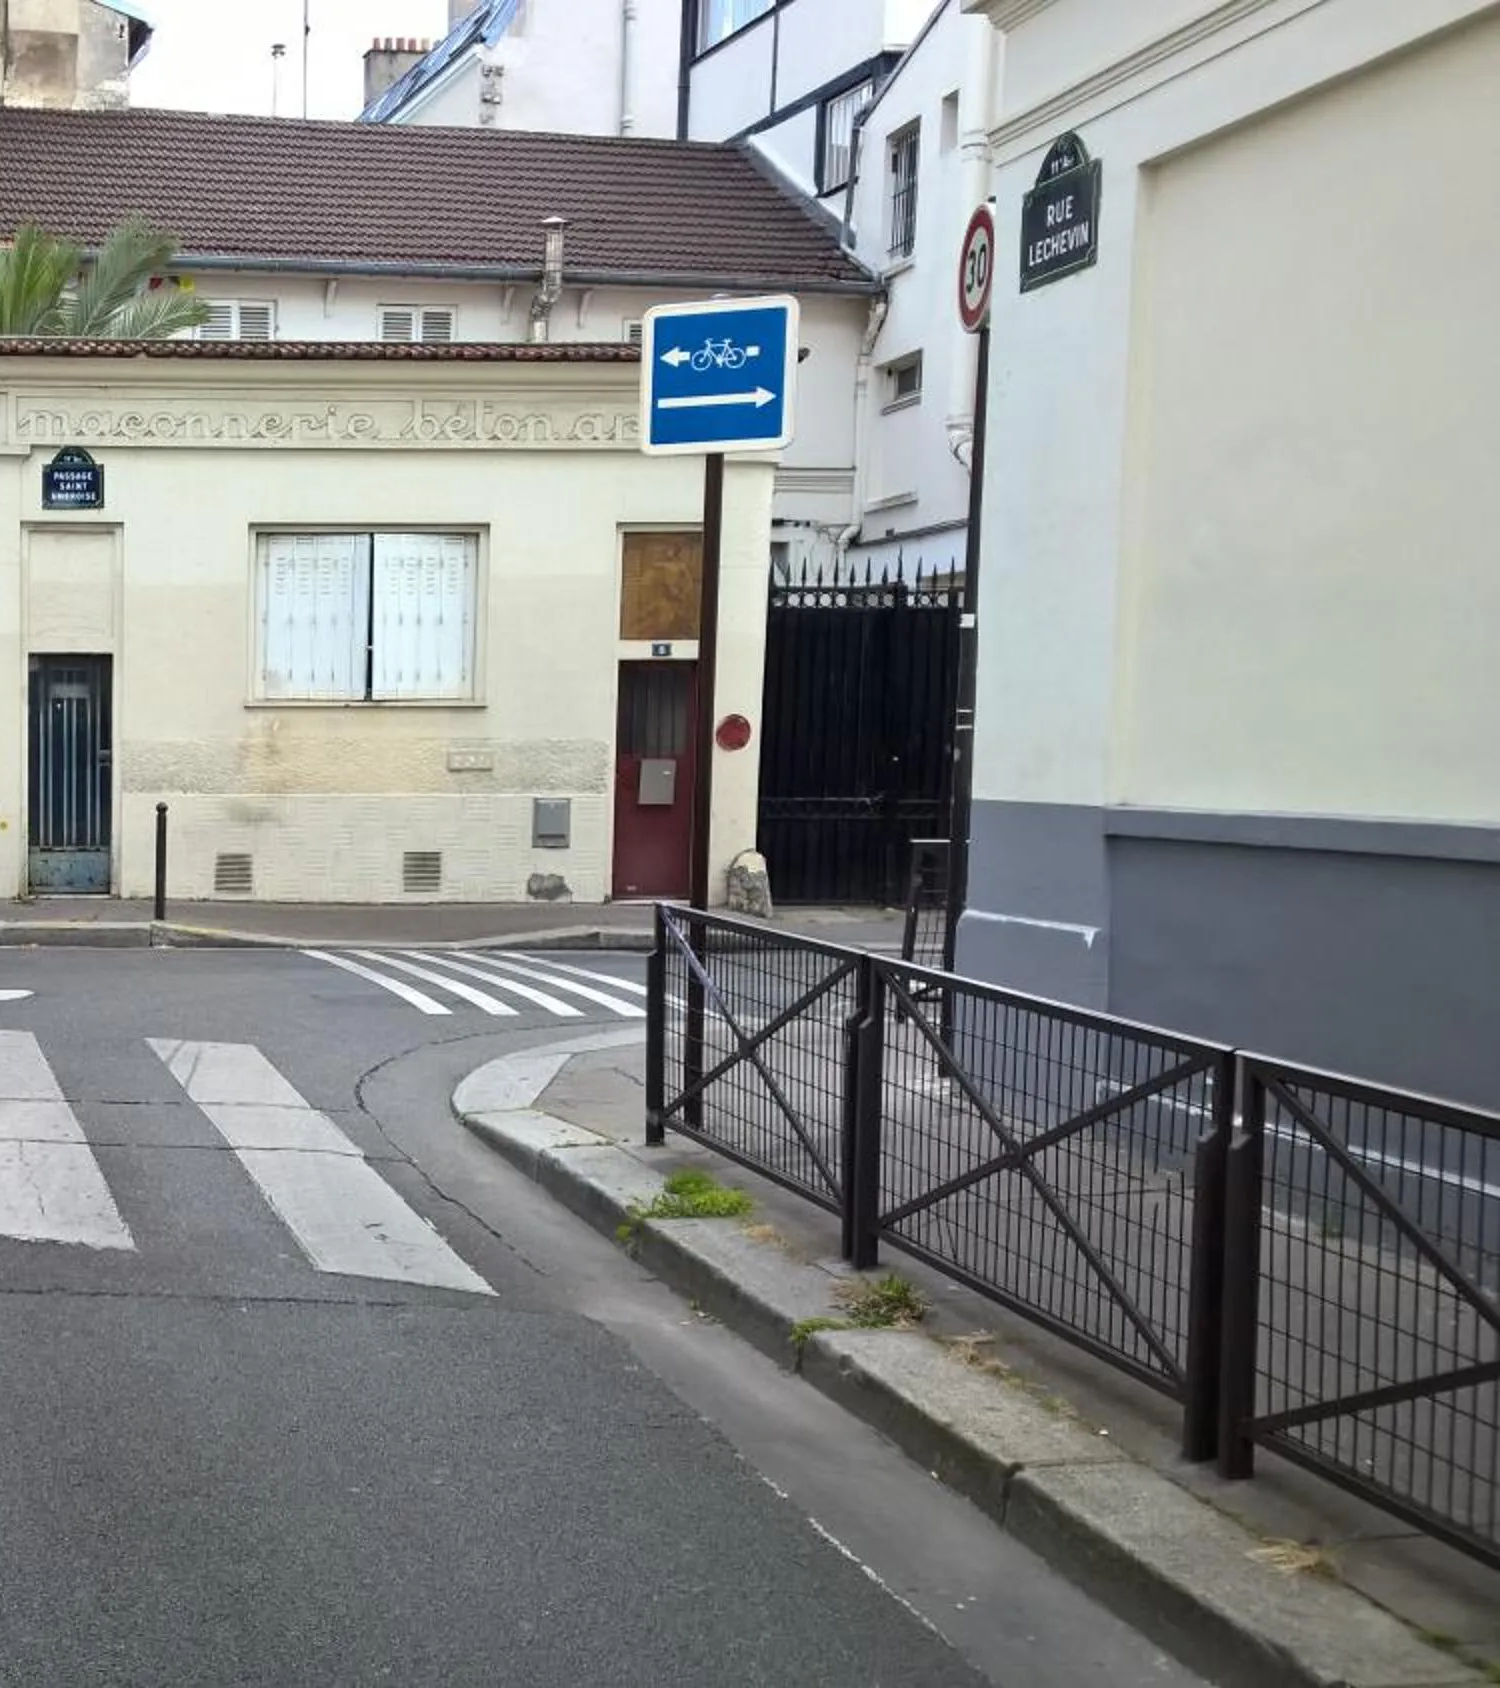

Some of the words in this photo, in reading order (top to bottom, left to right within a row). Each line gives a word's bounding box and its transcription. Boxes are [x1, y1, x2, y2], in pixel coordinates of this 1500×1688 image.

[1046, 195, 1075, 227] RUE
[1028, 222, 1090, 267] LECHEVIN
[966, 243, 987, 294] 30
[53, 471, 93, 481] PASSAGE
[59, 481, 88, 491] SAINT
[51, 492, 96, 501] AMBROISE
